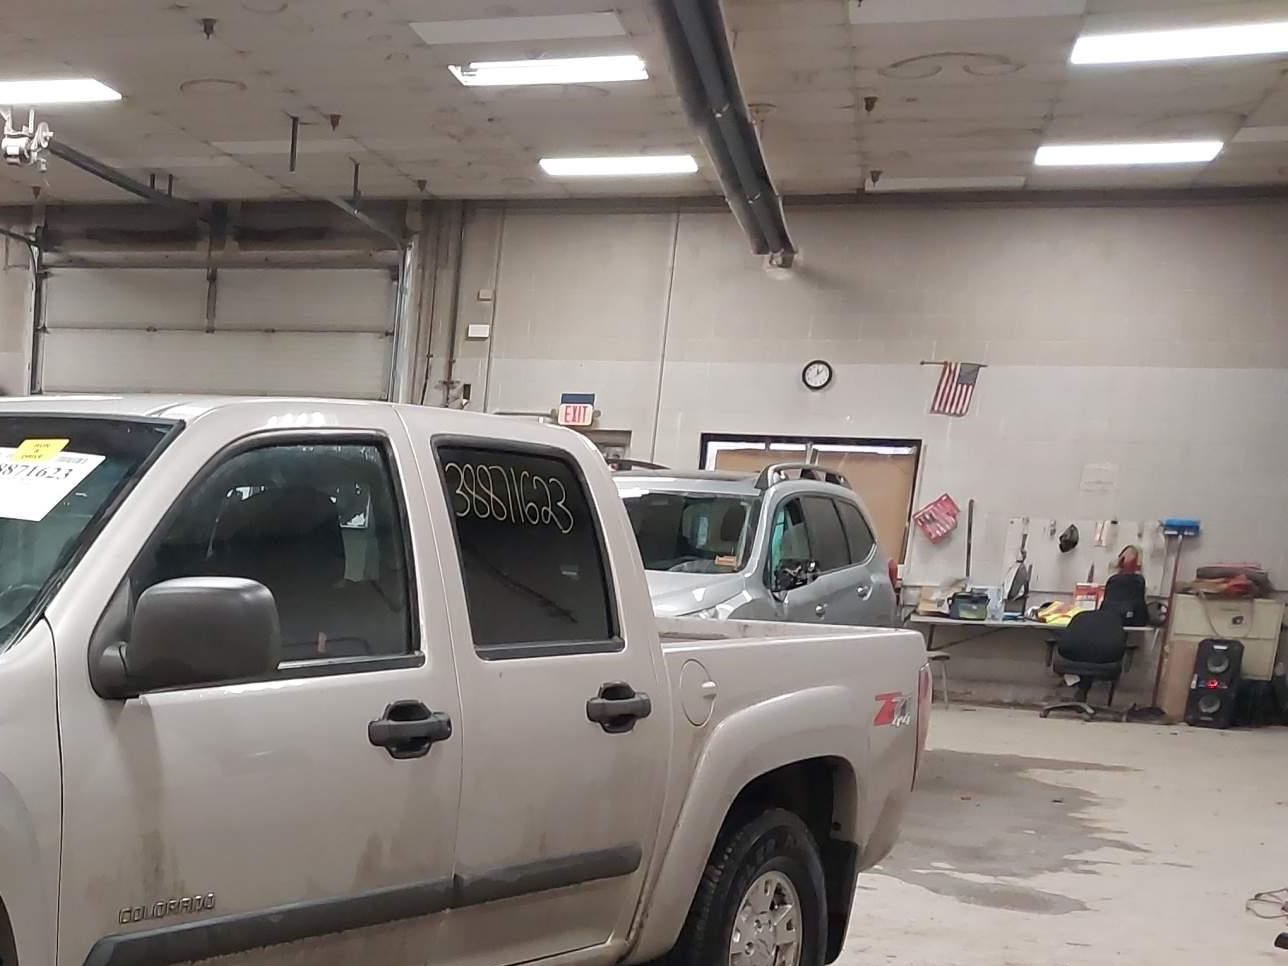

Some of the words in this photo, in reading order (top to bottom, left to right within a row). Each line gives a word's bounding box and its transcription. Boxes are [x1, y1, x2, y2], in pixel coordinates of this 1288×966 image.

[564, 405, 588, 423] EXIT
[445, 462, 574, 534] 38871623
[118, 892, 216, 925] COLORADO
